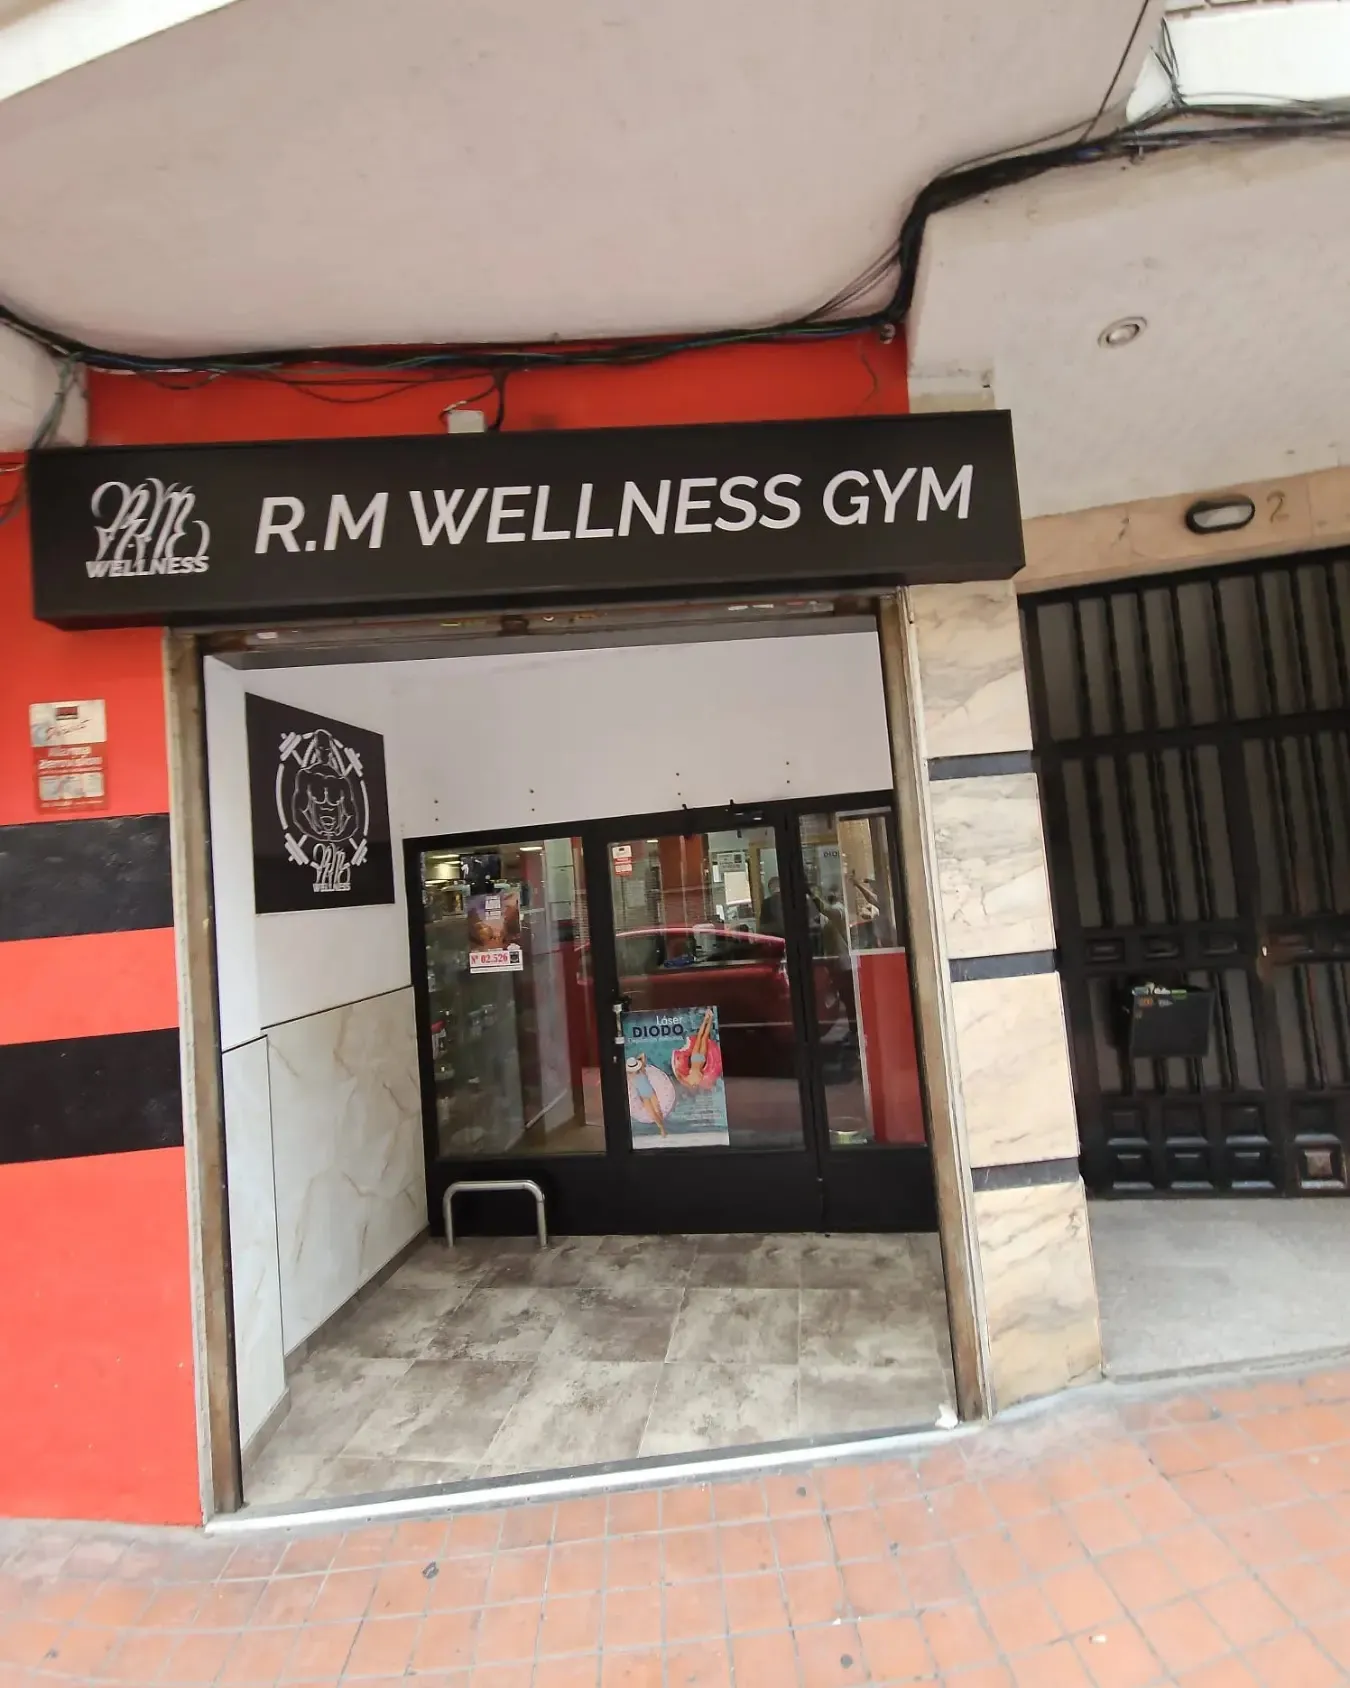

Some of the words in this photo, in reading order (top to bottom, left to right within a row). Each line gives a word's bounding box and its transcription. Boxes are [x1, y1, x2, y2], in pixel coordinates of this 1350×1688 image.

[254, 491, 389, 554] R.M
[409, 473, 802, 547] WELLNESS
[822, 463, 974, 526] GYM
[1266, 490, 1290, 524] 2
[85, 555, 210, 578] WELLNESS
[632, 1023, 684, 1038] DIODO
